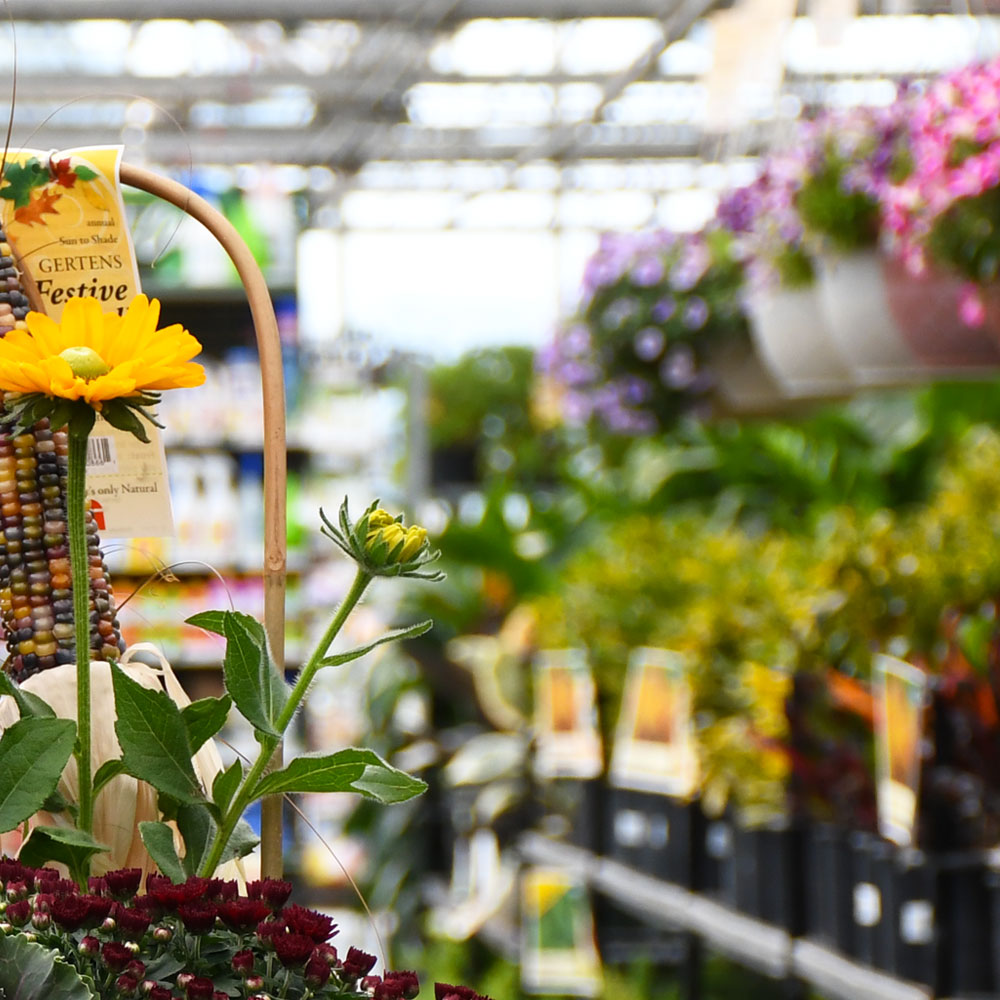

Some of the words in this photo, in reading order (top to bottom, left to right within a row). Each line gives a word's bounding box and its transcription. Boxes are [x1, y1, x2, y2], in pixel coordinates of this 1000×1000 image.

[87, 218, 115, 227] annual
[59, 236, 77, 246] Sun
[79, 235, 89, 245] to
[91, 233, 118, 244] Shade
[39, 255, 122, 273] GERTENS
[36, 278, 128, 305] Festive
[97, 484, 120, 498] only
[121, 481, 158, 494] Natural
